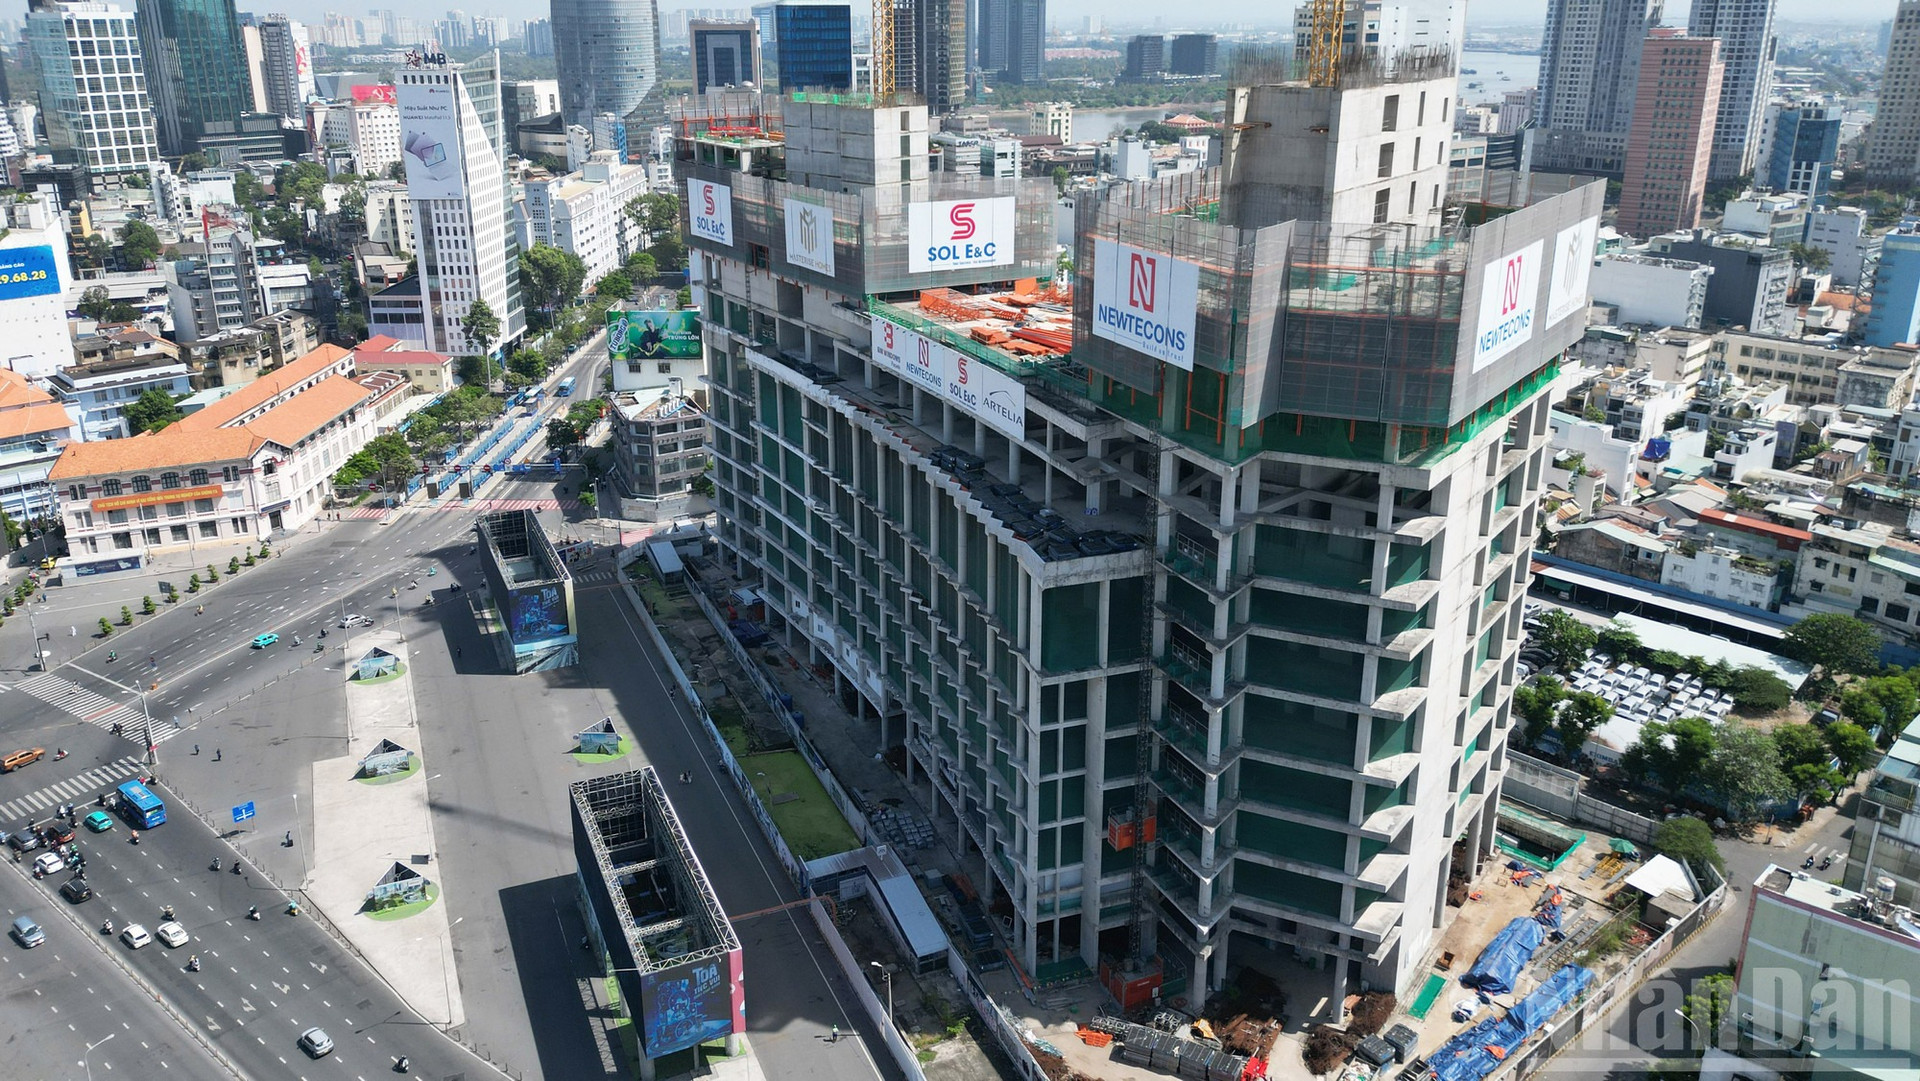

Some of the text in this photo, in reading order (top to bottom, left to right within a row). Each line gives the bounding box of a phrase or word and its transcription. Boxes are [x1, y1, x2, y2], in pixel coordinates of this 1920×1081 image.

[424, 53, 446, 65] MB
[696, 216, 725, 236] SOL E&C
[928, 242, 996, 261] SOL E&C
[0, 270, 47, 284] 9.68.28
[609, 318, 628, 350] TUBORG
[1098, 303, 1186, 352] NEWTECONS
[1478, 308, 1531, 355] NEWTECONS
[906, 362, 942, 387] NEWTECONS
[949, 382, 963, 399] SOL
[963, 390, 977, 406] E&C
[983, 397, 1024, 428] ARTELIA
